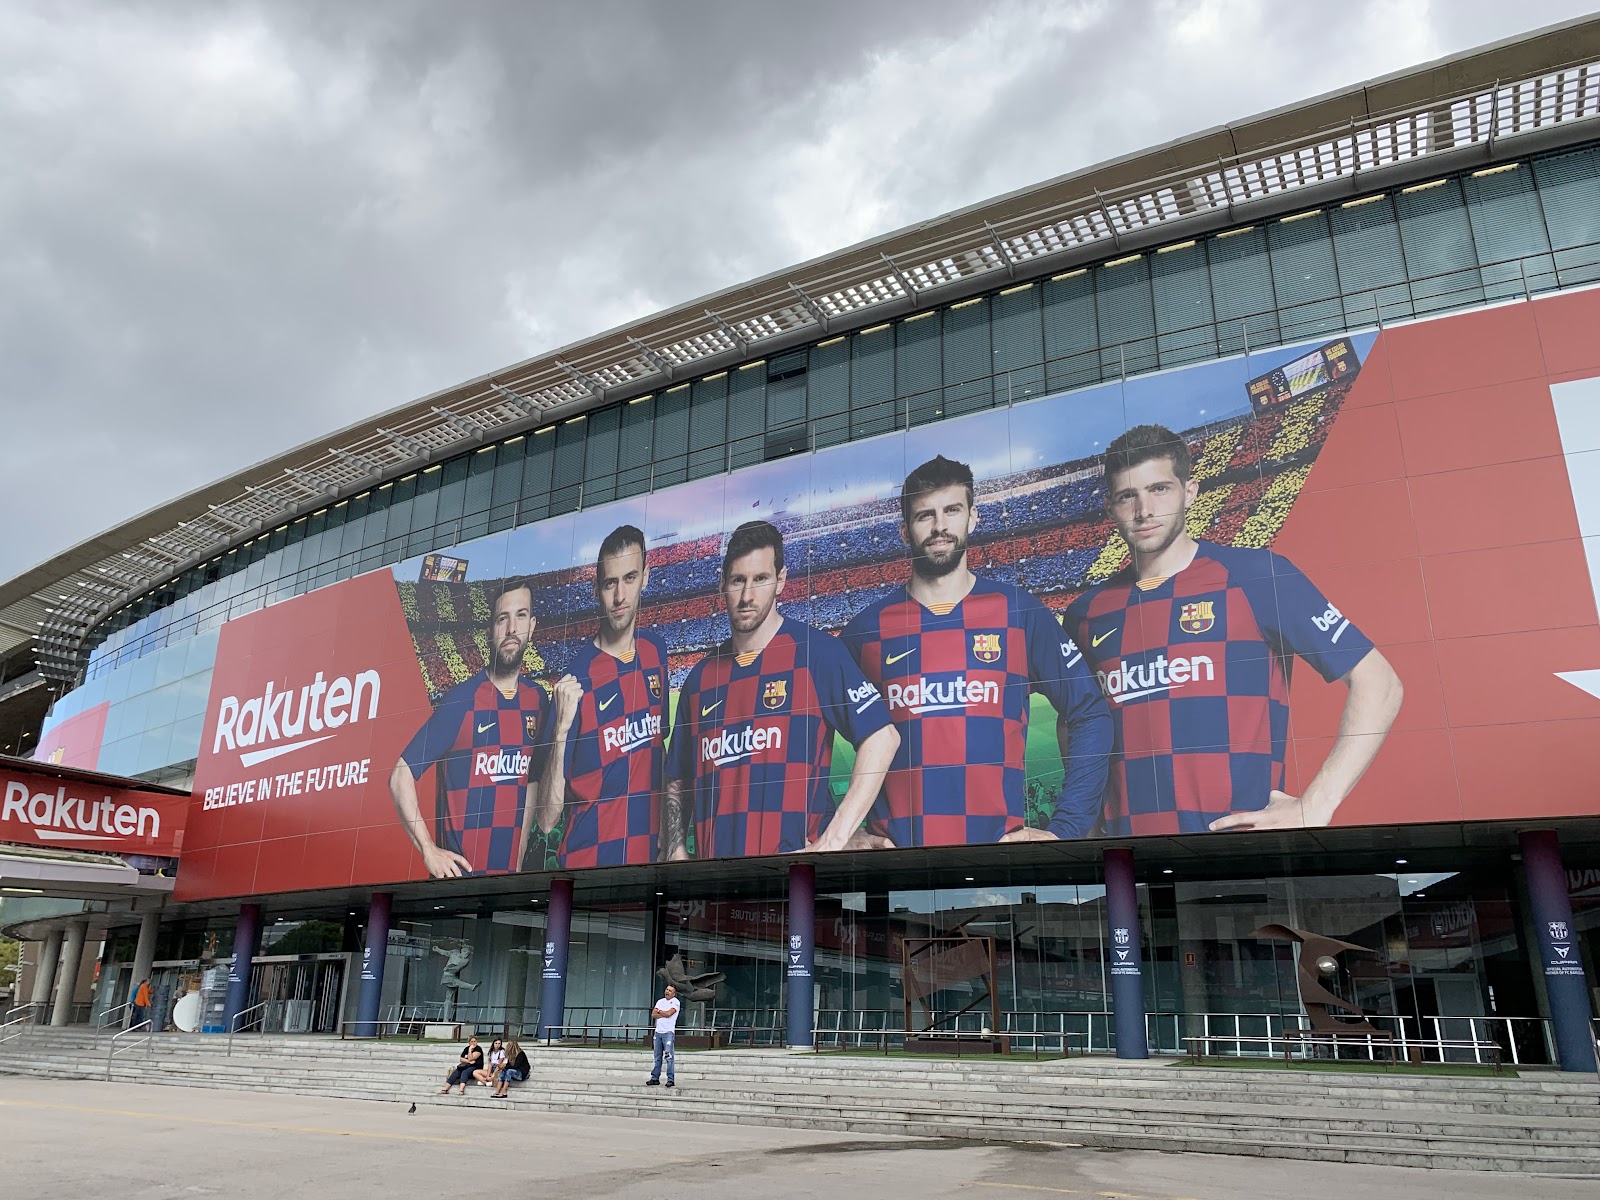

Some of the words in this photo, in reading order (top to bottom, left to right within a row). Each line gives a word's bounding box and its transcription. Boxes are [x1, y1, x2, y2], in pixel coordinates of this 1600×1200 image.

[1060, 638, 1078, 657] be
[847, 680, 878, 702] bek
[888, 676, 999, 710] Rakuten
[212, 670, 380, 754] Rakuten
[702, 725, 782, 762] Rakuten
[203, 780, 256, 811] BELIEVE
[256, 776, 272, 800] IN
[275, 771, 304, 798] THE
[305, 758, 370, 792] FUTURE
[1, 780, 160, 838] Rakuten
